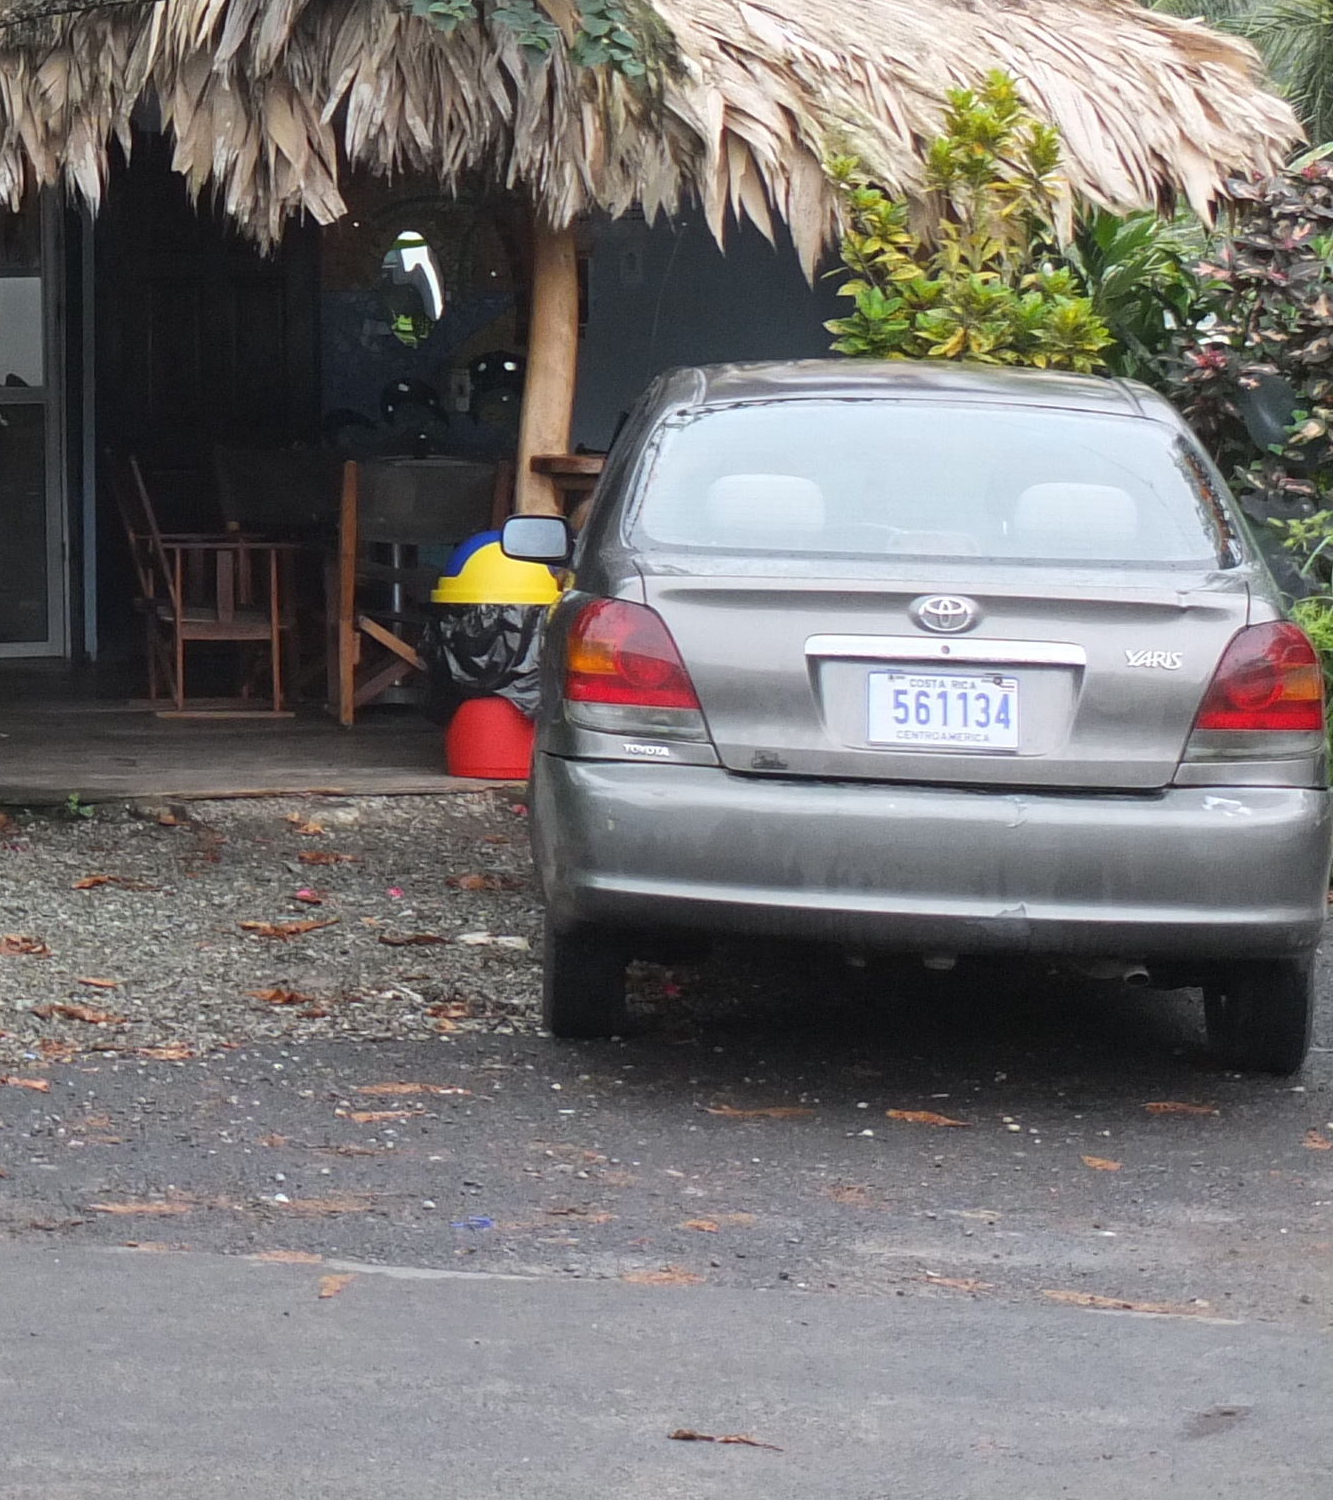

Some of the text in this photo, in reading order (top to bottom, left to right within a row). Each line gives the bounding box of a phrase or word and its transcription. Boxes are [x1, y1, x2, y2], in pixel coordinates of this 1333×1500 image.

[1124, 649, 1184, 671] YARIS
[909, 678, 977, 690] COSTA RICA
[893, 689, 1011, 730] 561134
[896, 730, 991, 743] CENTROAMERICA
[623, 743, 671, 757] TOYOTA
